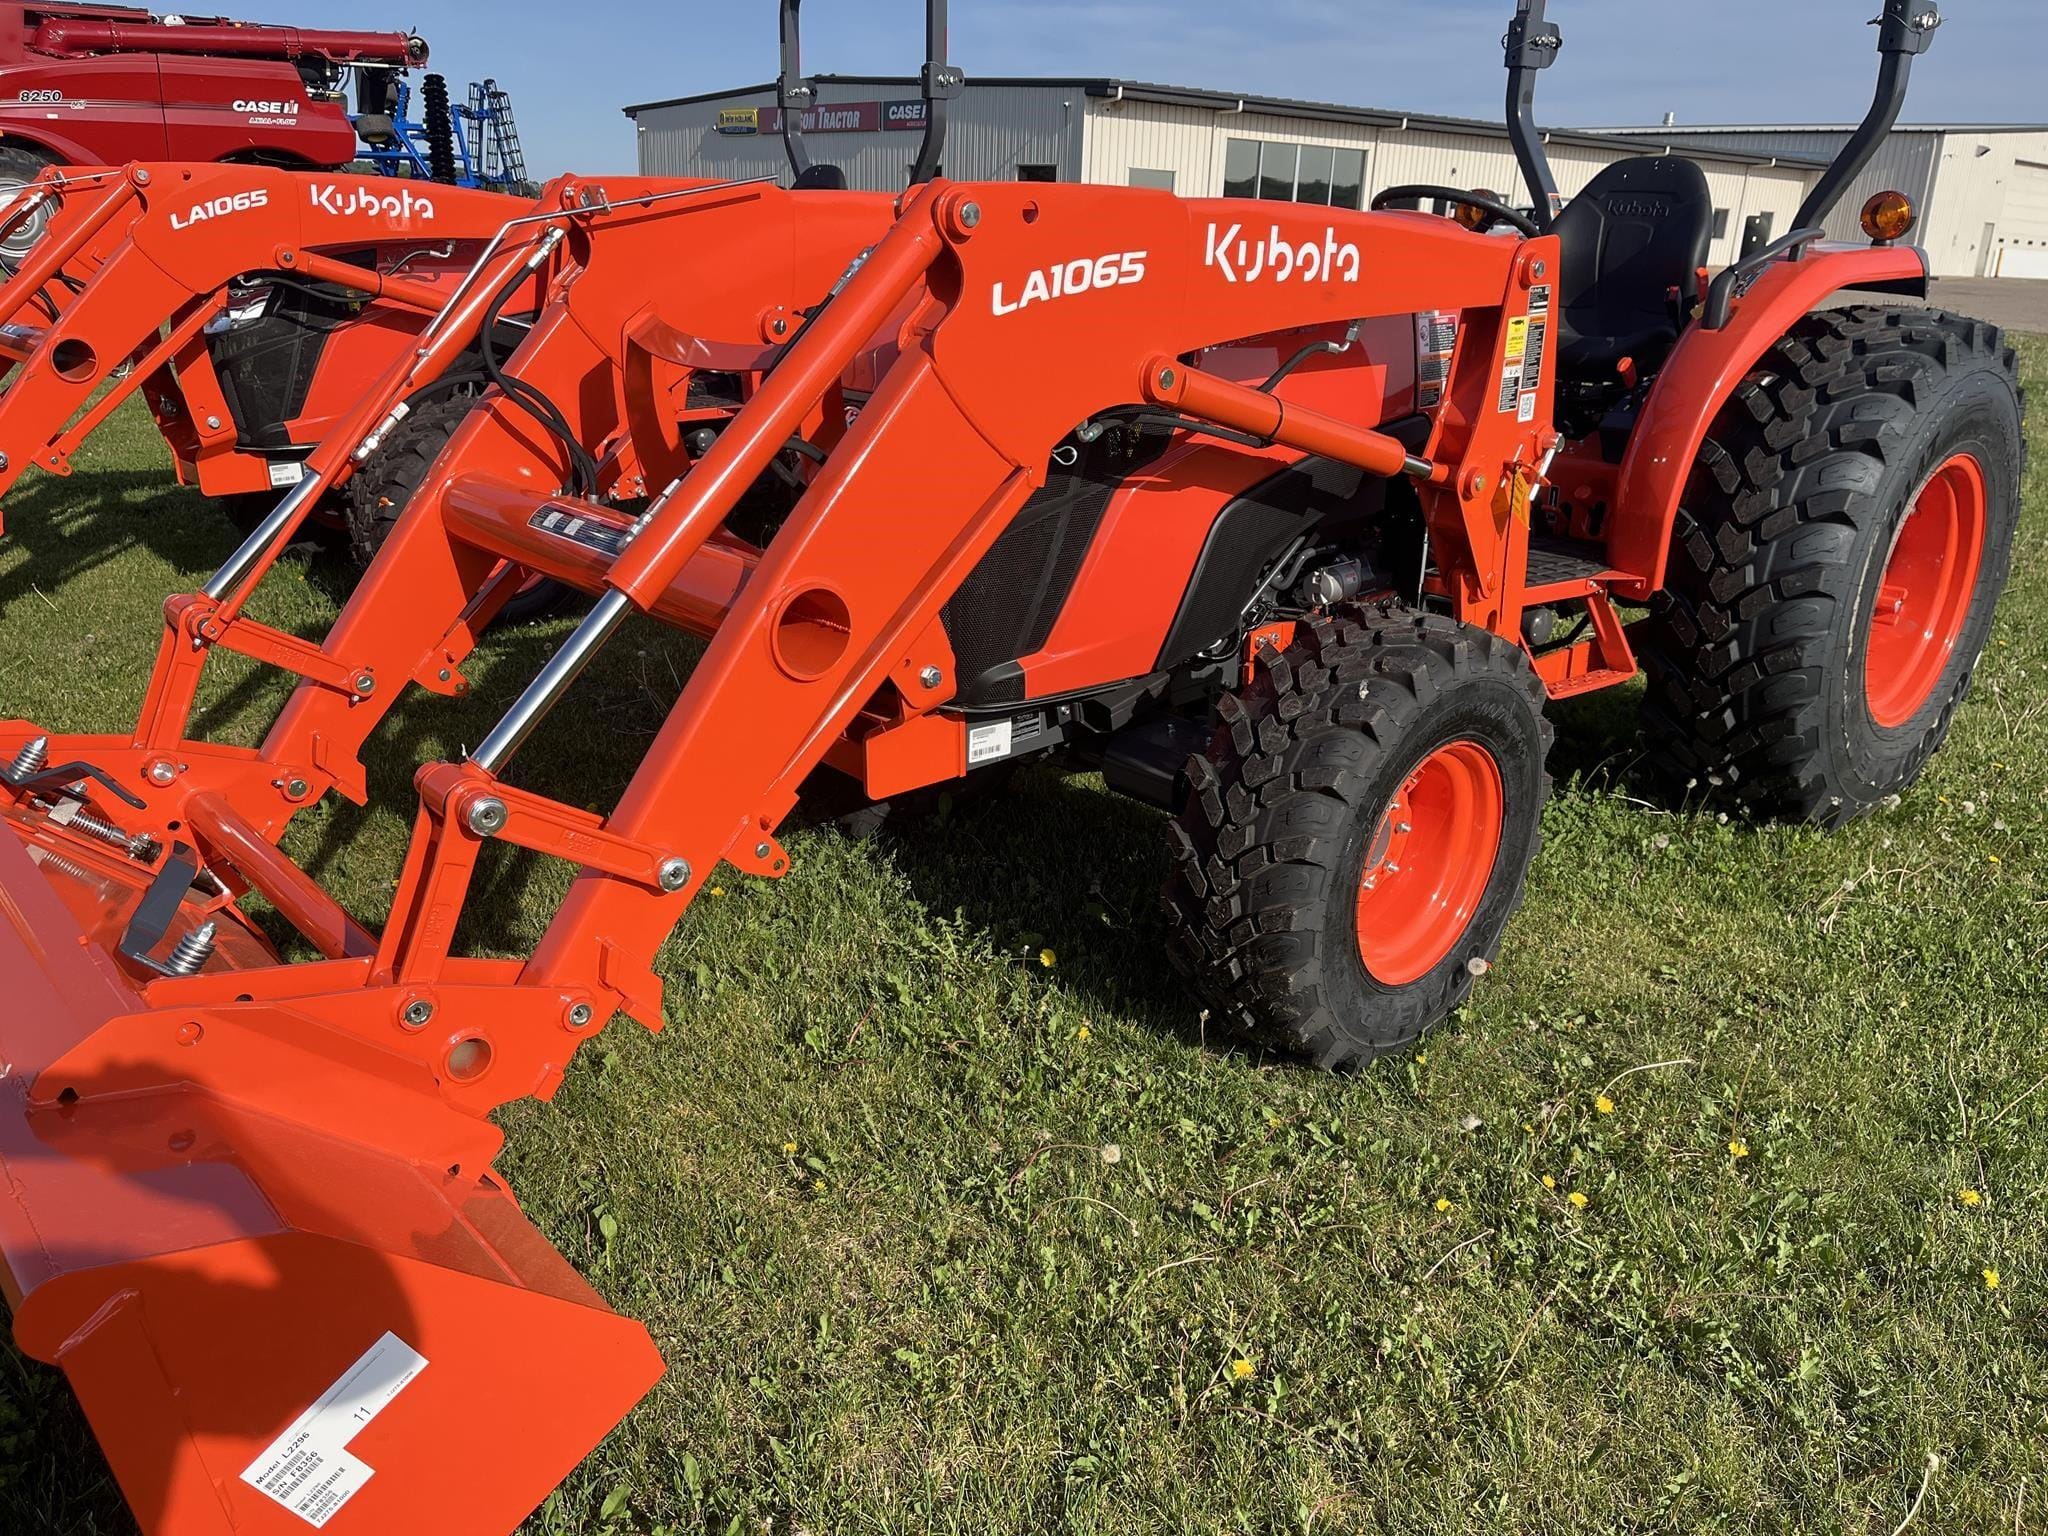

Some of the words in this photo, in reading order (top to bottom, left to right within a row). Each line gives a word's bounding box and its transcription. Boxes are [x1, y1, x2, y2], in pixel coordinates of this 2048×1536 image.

[20, 90, 62, 102] 8250
[233, 100, 281, 113] CASE
[818, 107, 860, 129] TRACTOR
[889, 105, 920, 120] CASE
[170, 189, 268, 230] LA1065
[311, 184, 435, 219] Kubota
[1608, 200, 1670, 217] Kubota
[1205, 223, 1361, 283] Kubota
[992, 251, 1148, 316] LA1065
[353, 1406, 371, 1421] 11
[256, 1460, 281, 1484] Model
[281, 1431, 310, 1458] L2296
[272, 1481, 287, 1495] S/N
[290, 1450, 318, 1477] F8356
